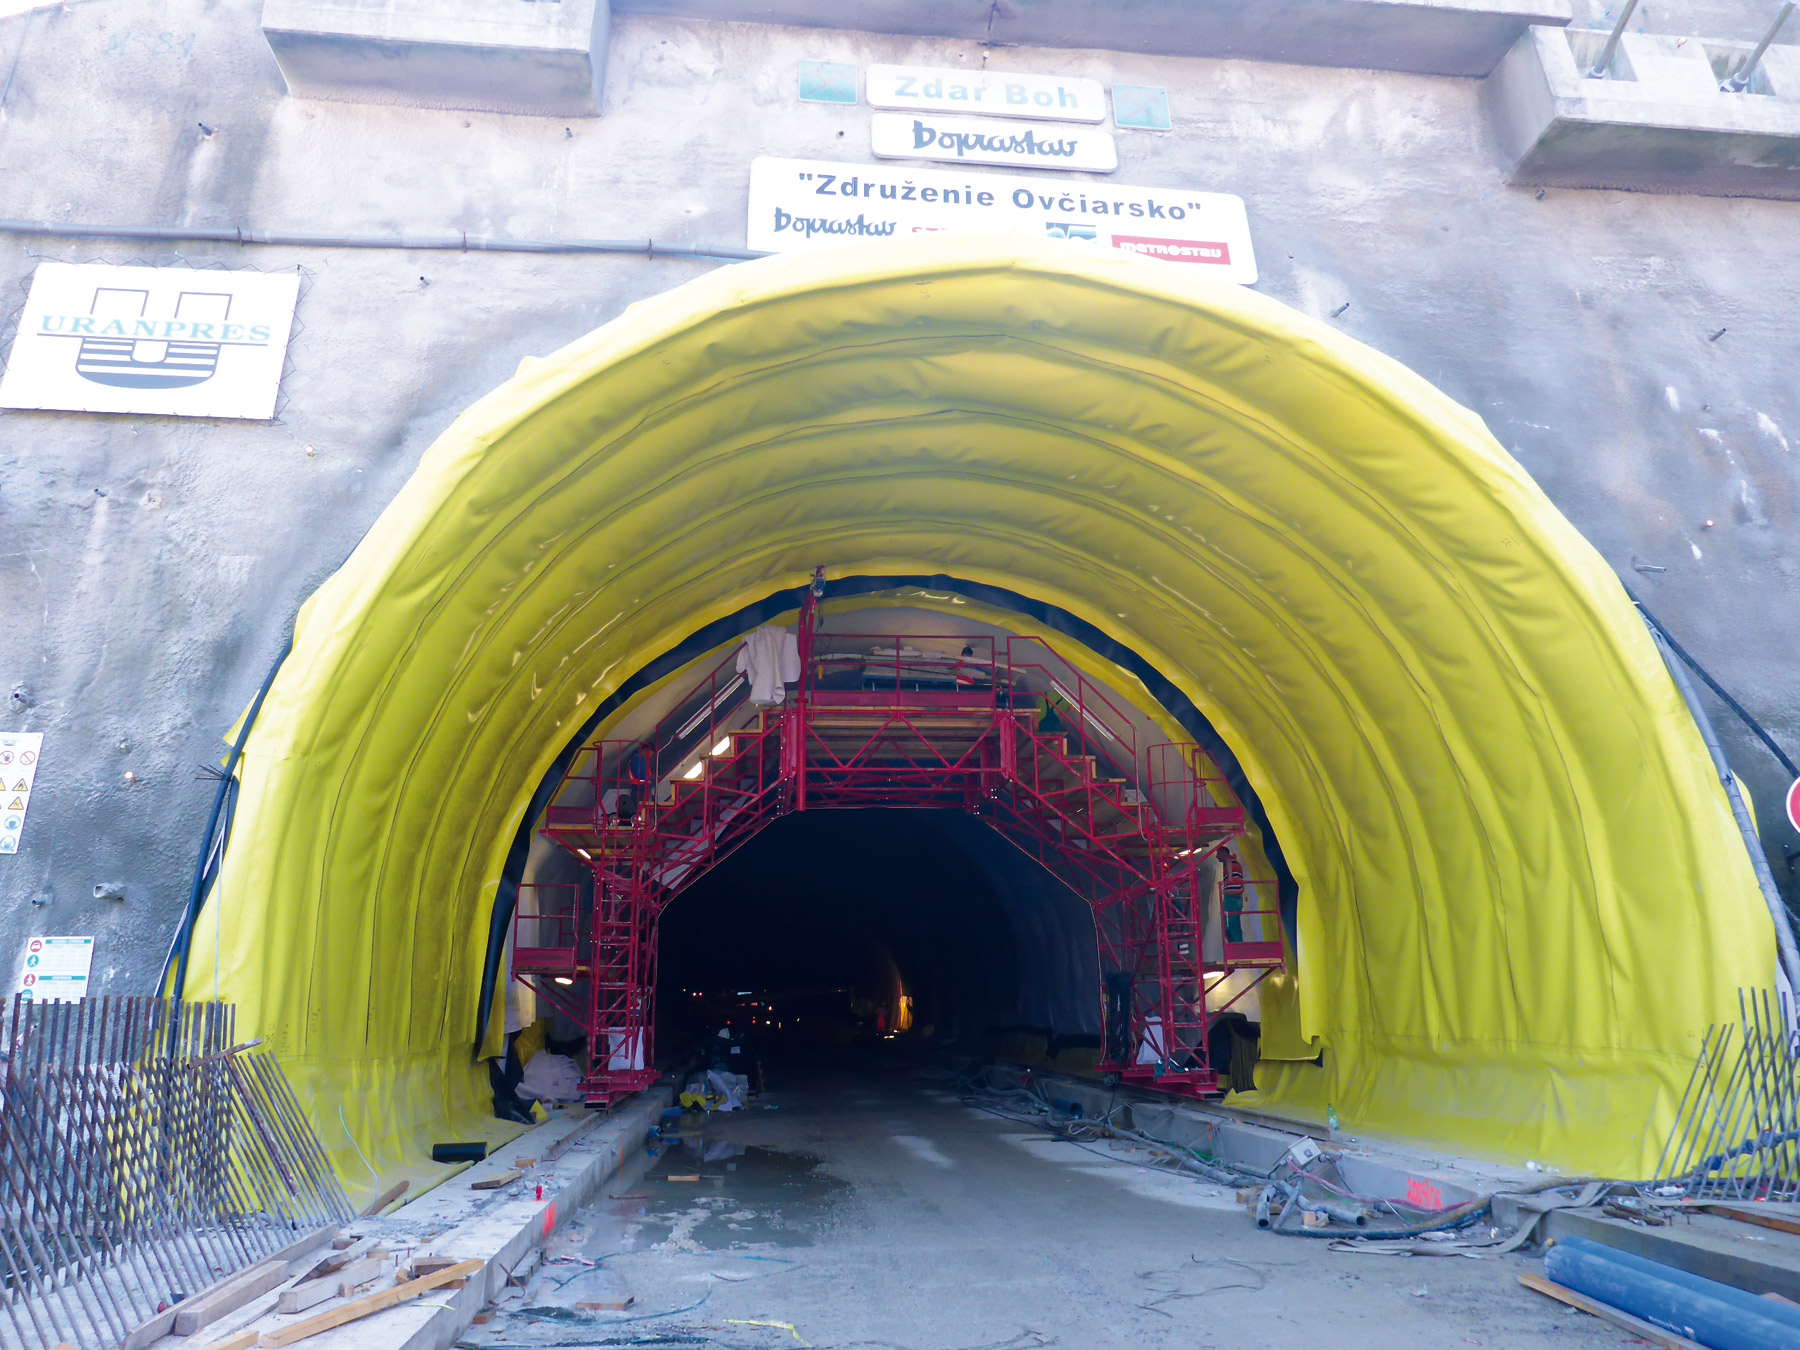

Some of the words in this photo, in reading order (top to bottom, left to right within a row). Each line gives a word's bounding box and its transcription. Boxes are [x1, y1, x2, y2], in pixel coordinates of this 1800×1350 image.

[894, 76, 988, 102] Zdar
[1004, 83, 1079, 109] Boh
[798, 173, 996, 207] "Združenie
[1012, 188, 1201, 220] Ovčiarsko"
[40, 315, 271, 342] URANPRES
